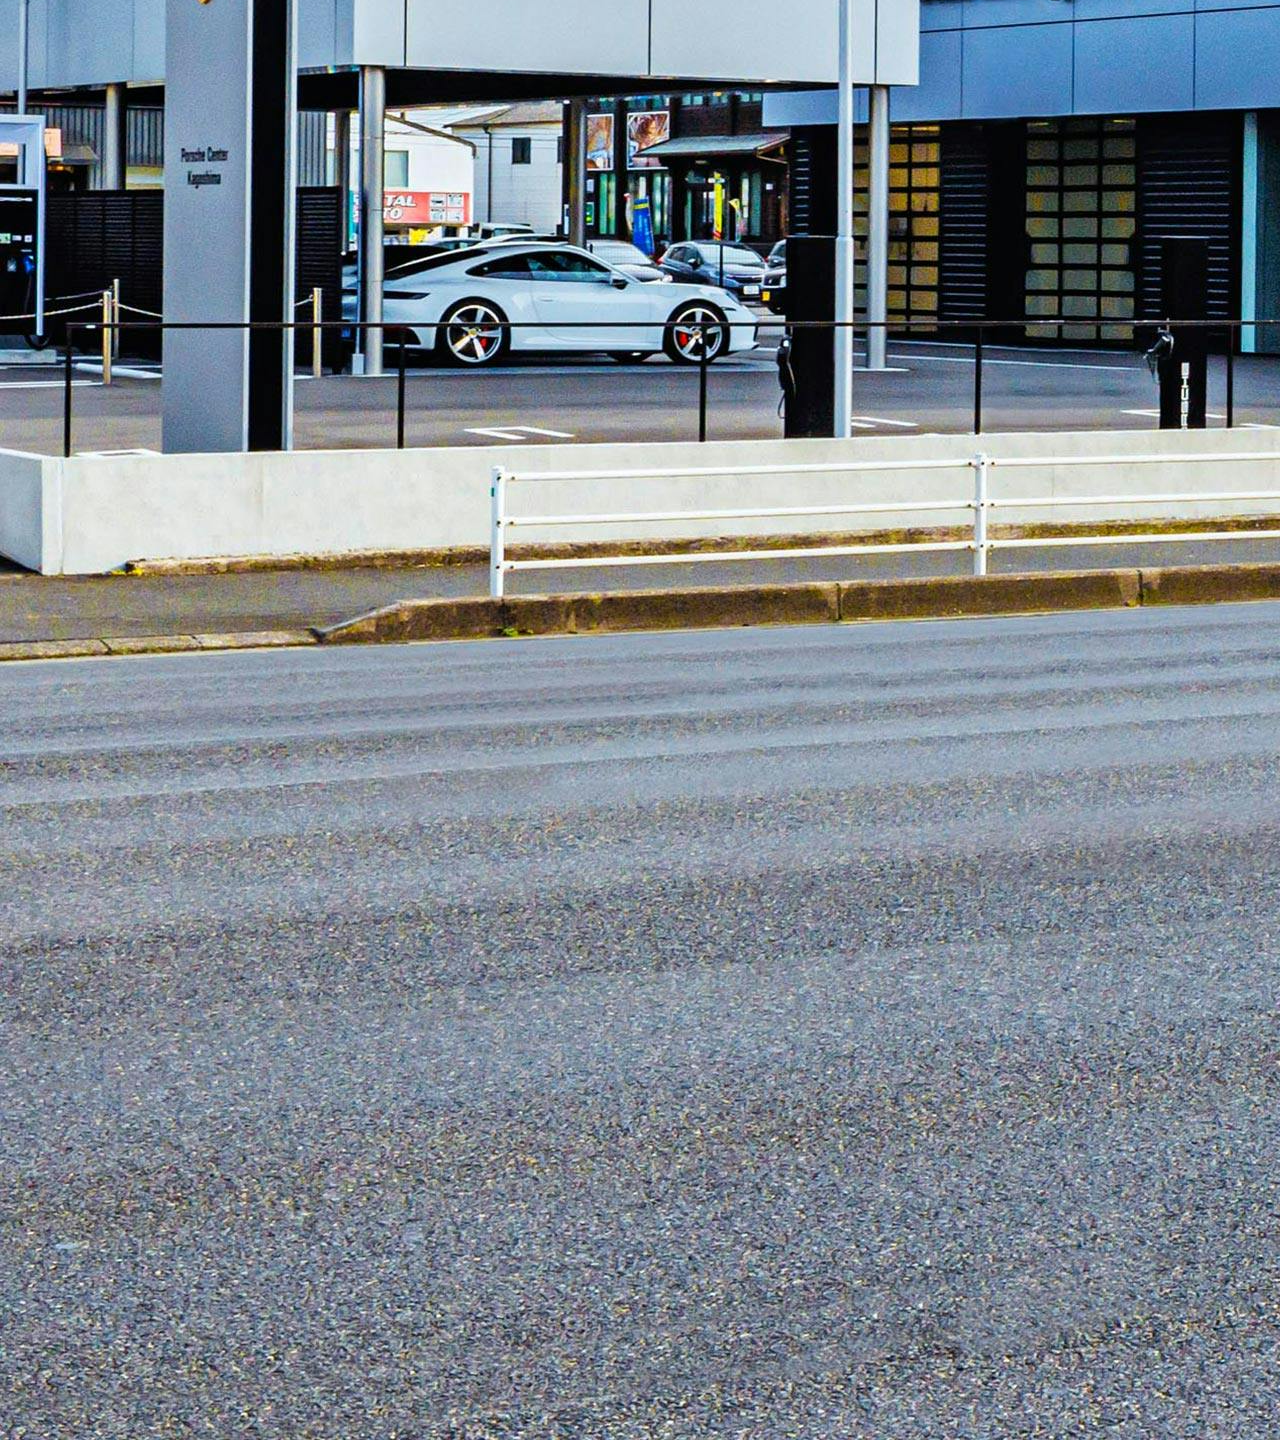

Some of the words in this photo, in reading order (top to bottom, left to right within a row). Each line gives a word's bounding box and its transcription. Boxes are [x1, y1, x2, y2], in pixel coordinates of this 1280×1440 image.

[181, 148, 205, 162] Porsche
[207, 146, 229, 161] Center
[384, 194, 417, 207] TAL
[383, 207, 403, 220] TO
[1181, 362, 1190, 429] RSCHE
